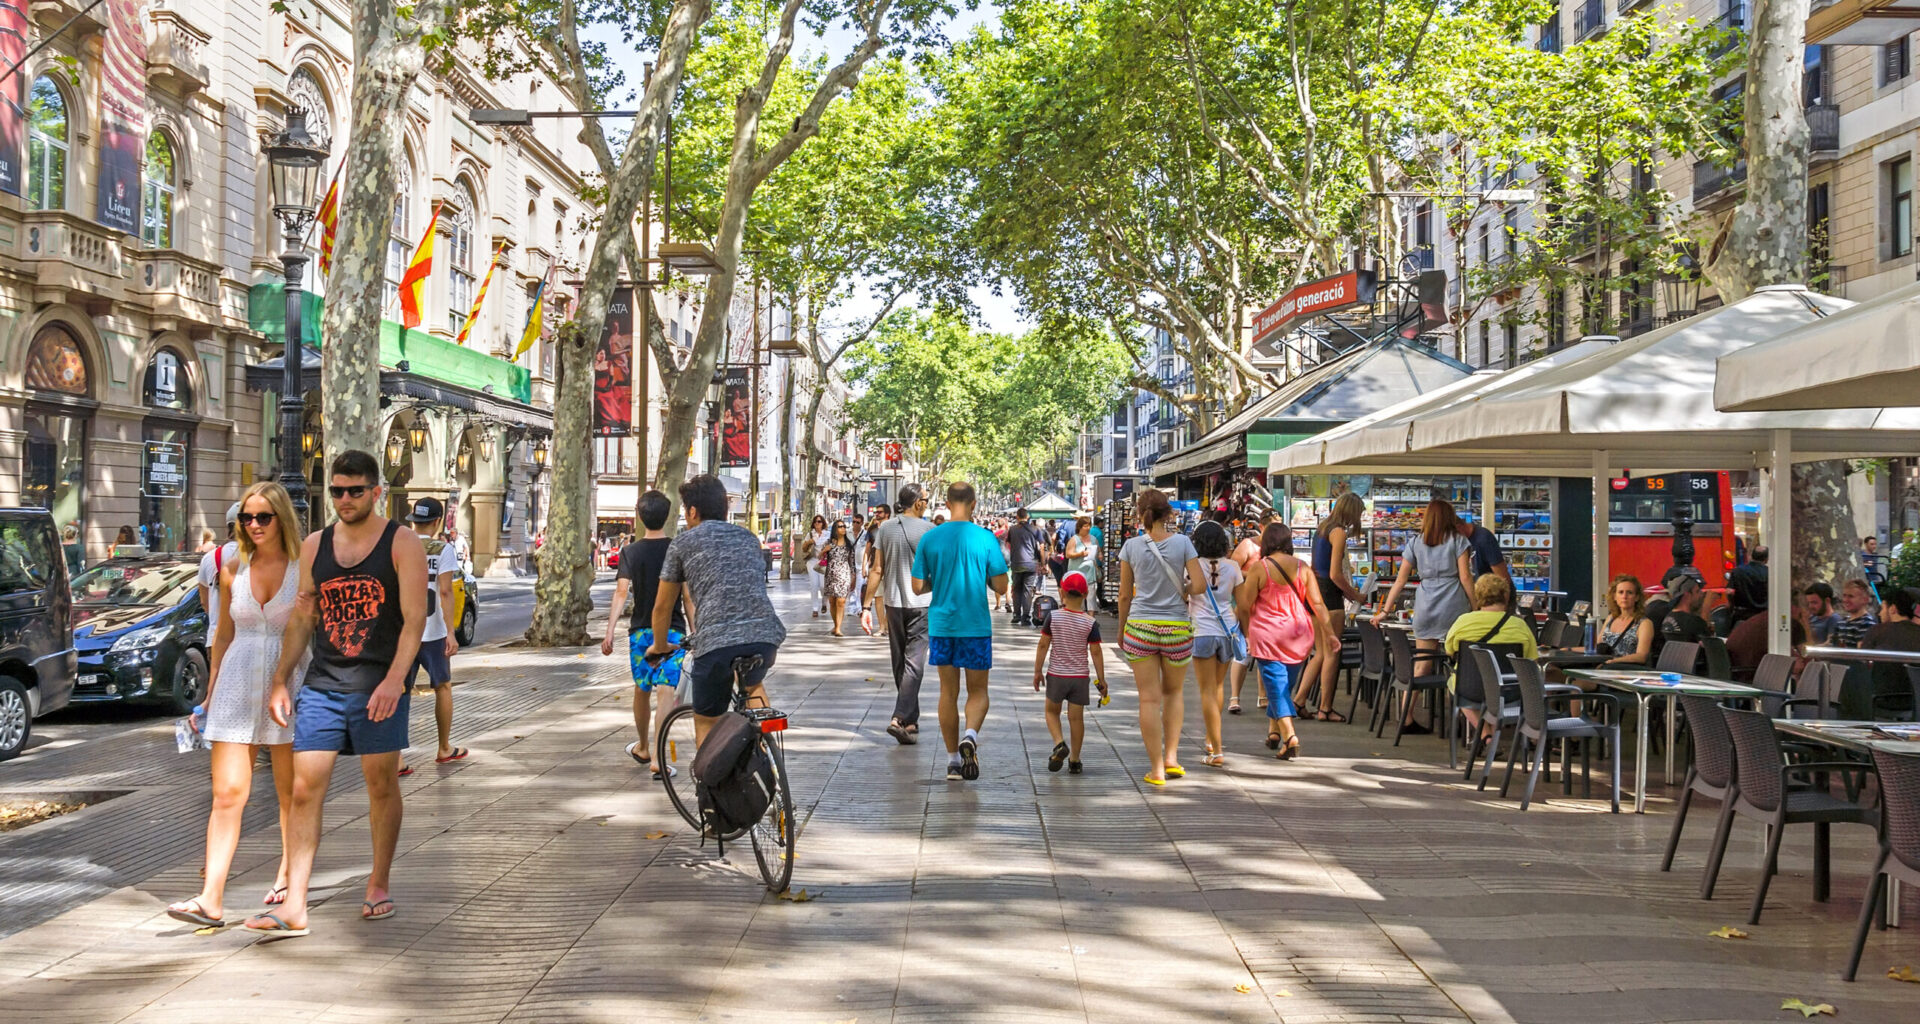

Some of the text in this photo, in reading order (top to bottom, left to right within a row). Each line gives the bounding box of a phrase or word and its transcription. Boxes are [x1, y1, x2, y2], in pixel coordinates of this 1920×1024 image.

[108, 196, 131, 216] Liceu
[1296, 280, 1344, 313] generació
[1647, 478, 1709, 490] 59 58
[325, 583, 370, 606] IBIZA
